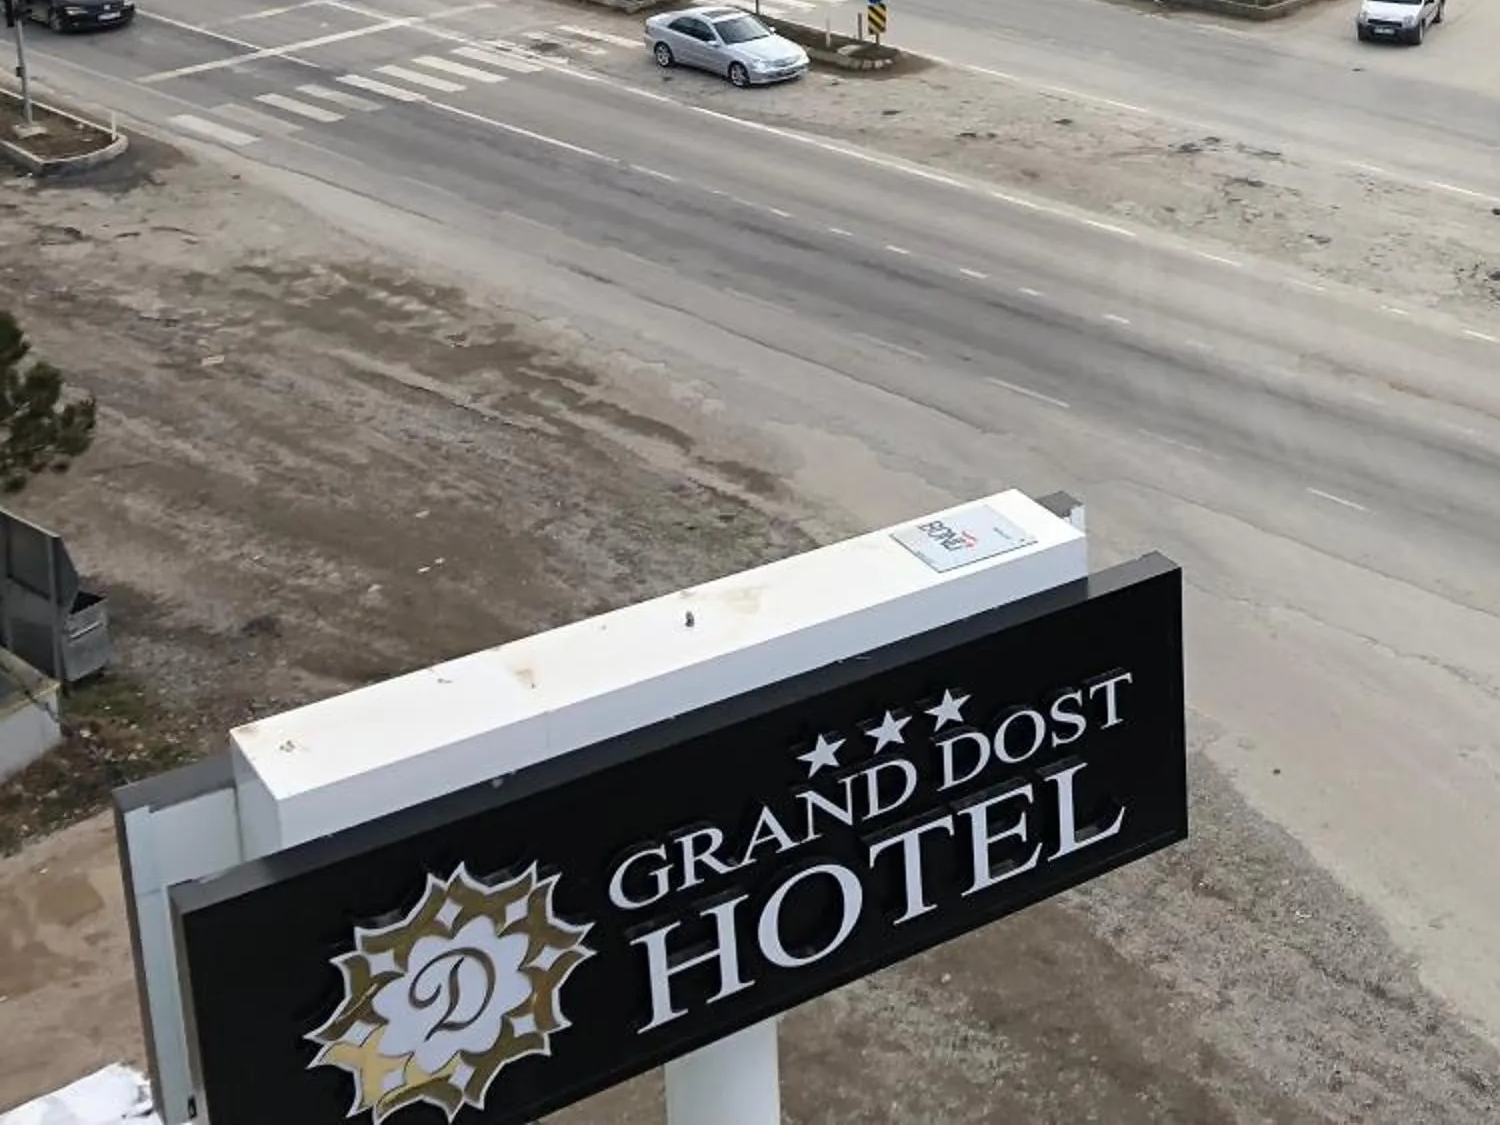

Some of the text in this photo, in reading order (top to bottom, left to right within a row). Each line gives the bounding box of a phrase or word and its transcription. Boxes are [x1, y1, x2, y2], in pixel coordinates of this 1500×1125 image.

[608, 672, 1133, 911] GRAND DOST
[629, 763, 1127, 1035] HOTEL
